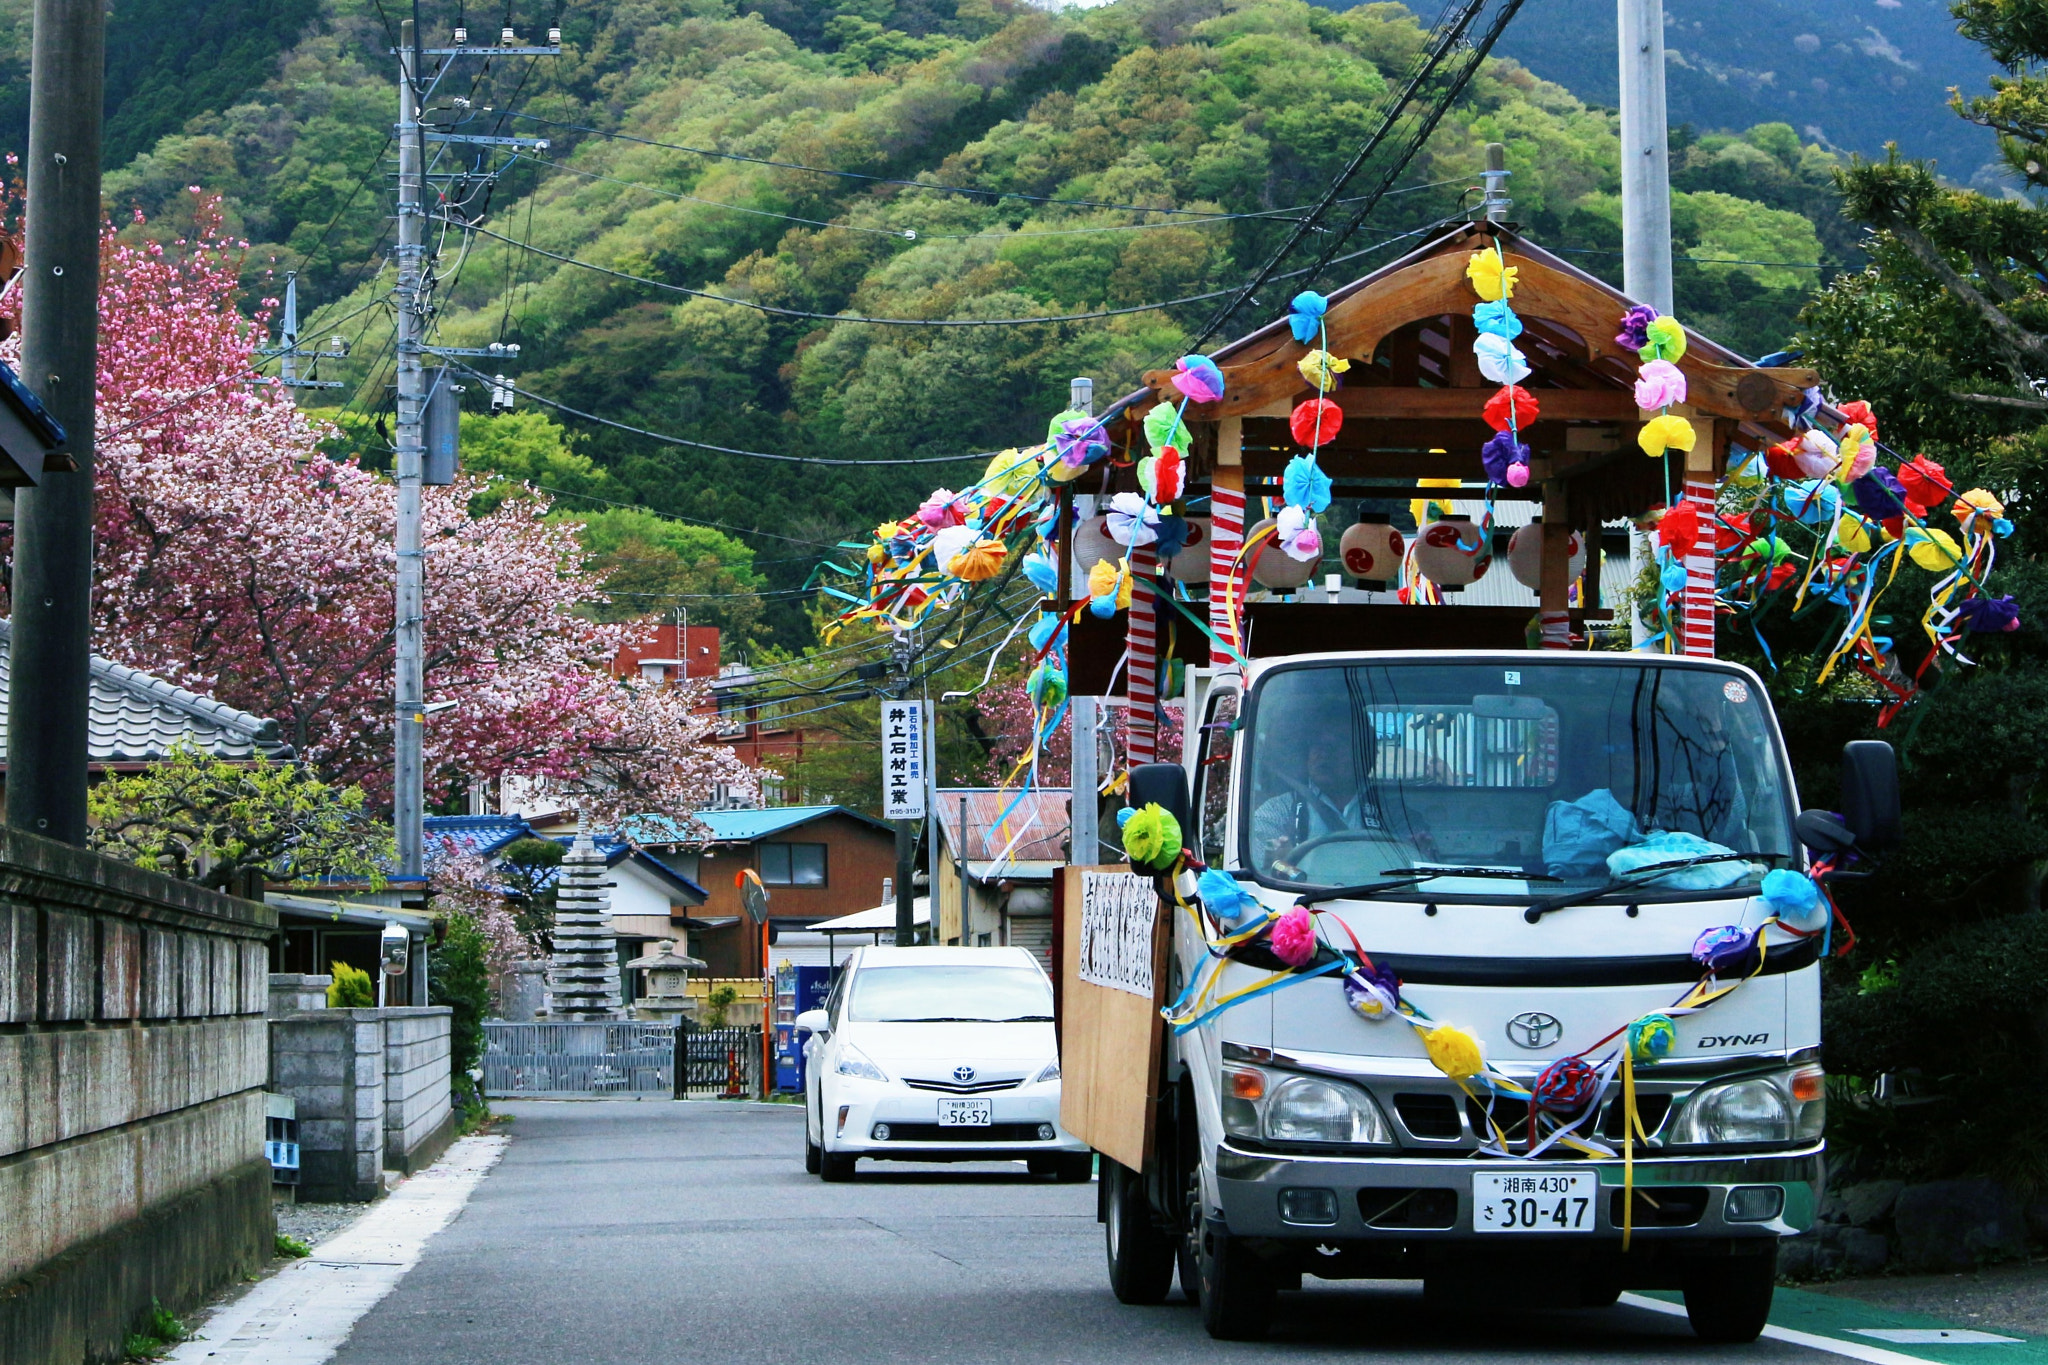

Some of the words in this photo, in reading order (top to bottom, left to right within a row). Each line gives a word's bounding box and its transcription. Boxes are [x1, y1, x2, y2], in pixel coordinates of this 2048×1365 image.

[1508, 673, 1514, 681] 2
[889, 708, 908, 805] 井上石材工業
[910, 762, 919, 779] 販売
[810, 980, 832, 990] Asah
[1698, 1033, 1769, 1048] DYNA
[950, 1110, 988, 1124] 56-52
[1503, 1177, 1568, 1193] 湘南430
[1484, 1205, 1494, 1221] さ
[1501, 1197, 1589, 1228] 30-47
